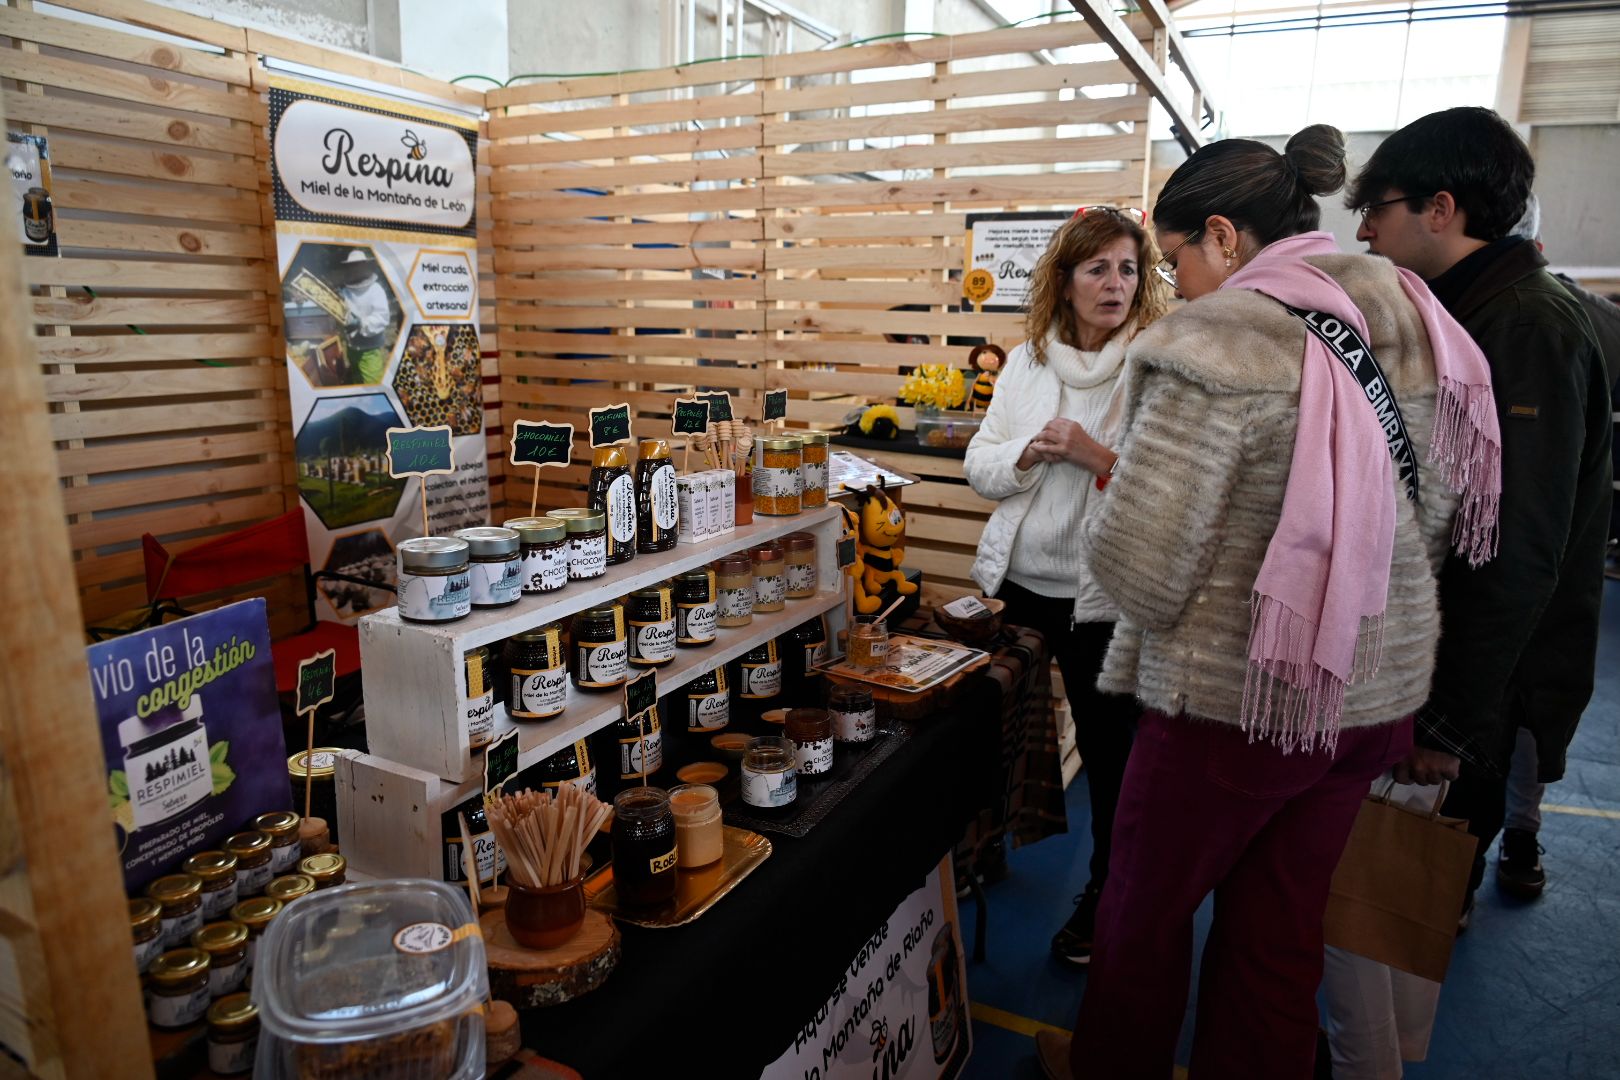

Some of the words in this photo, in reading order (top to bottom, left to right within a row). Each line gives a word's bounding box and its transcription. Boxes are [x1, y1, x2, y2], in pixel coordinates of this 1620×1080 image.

[322, 128, 454, 189] Respina
[301, 180, 330, 196] Miel
[334, 184, 350, 199] de
[352, 186, 364, 200] la
[367, 189, 421, 207] Montaña
[424, 196, 438, 209] de
[441, 197, 466, 212] León
[421, 262, 440, 273] Miel
[972, 276, 986, 286] 89
[423, 282, 470, 293] extracción
[426, 301, 469, 311] artesanal
[1305, 311, 1365, 371] LOLA
[1364, 375, 1406, 461] BIMBA
[626, 482, 635, 533] Respina
[668, 472, 677, 521] Respina
[145, 636, 177, 683] de
[184, 627, 207, 669] la
[137, 635, 256, 719] congestión
[137, 762, 206, 801] RESPIMIEL
[126, 838, 178, 870] CONCENTRADO
[178, 831, 188, 843] DE
[138, 825, 181, 852] PREPARADO
[182, 820, 192, 831] DE
[822, 976, 884, 1073] Montaña
[886, 952, 901, 981] de
[902, 908, 934, 960] Riaño
